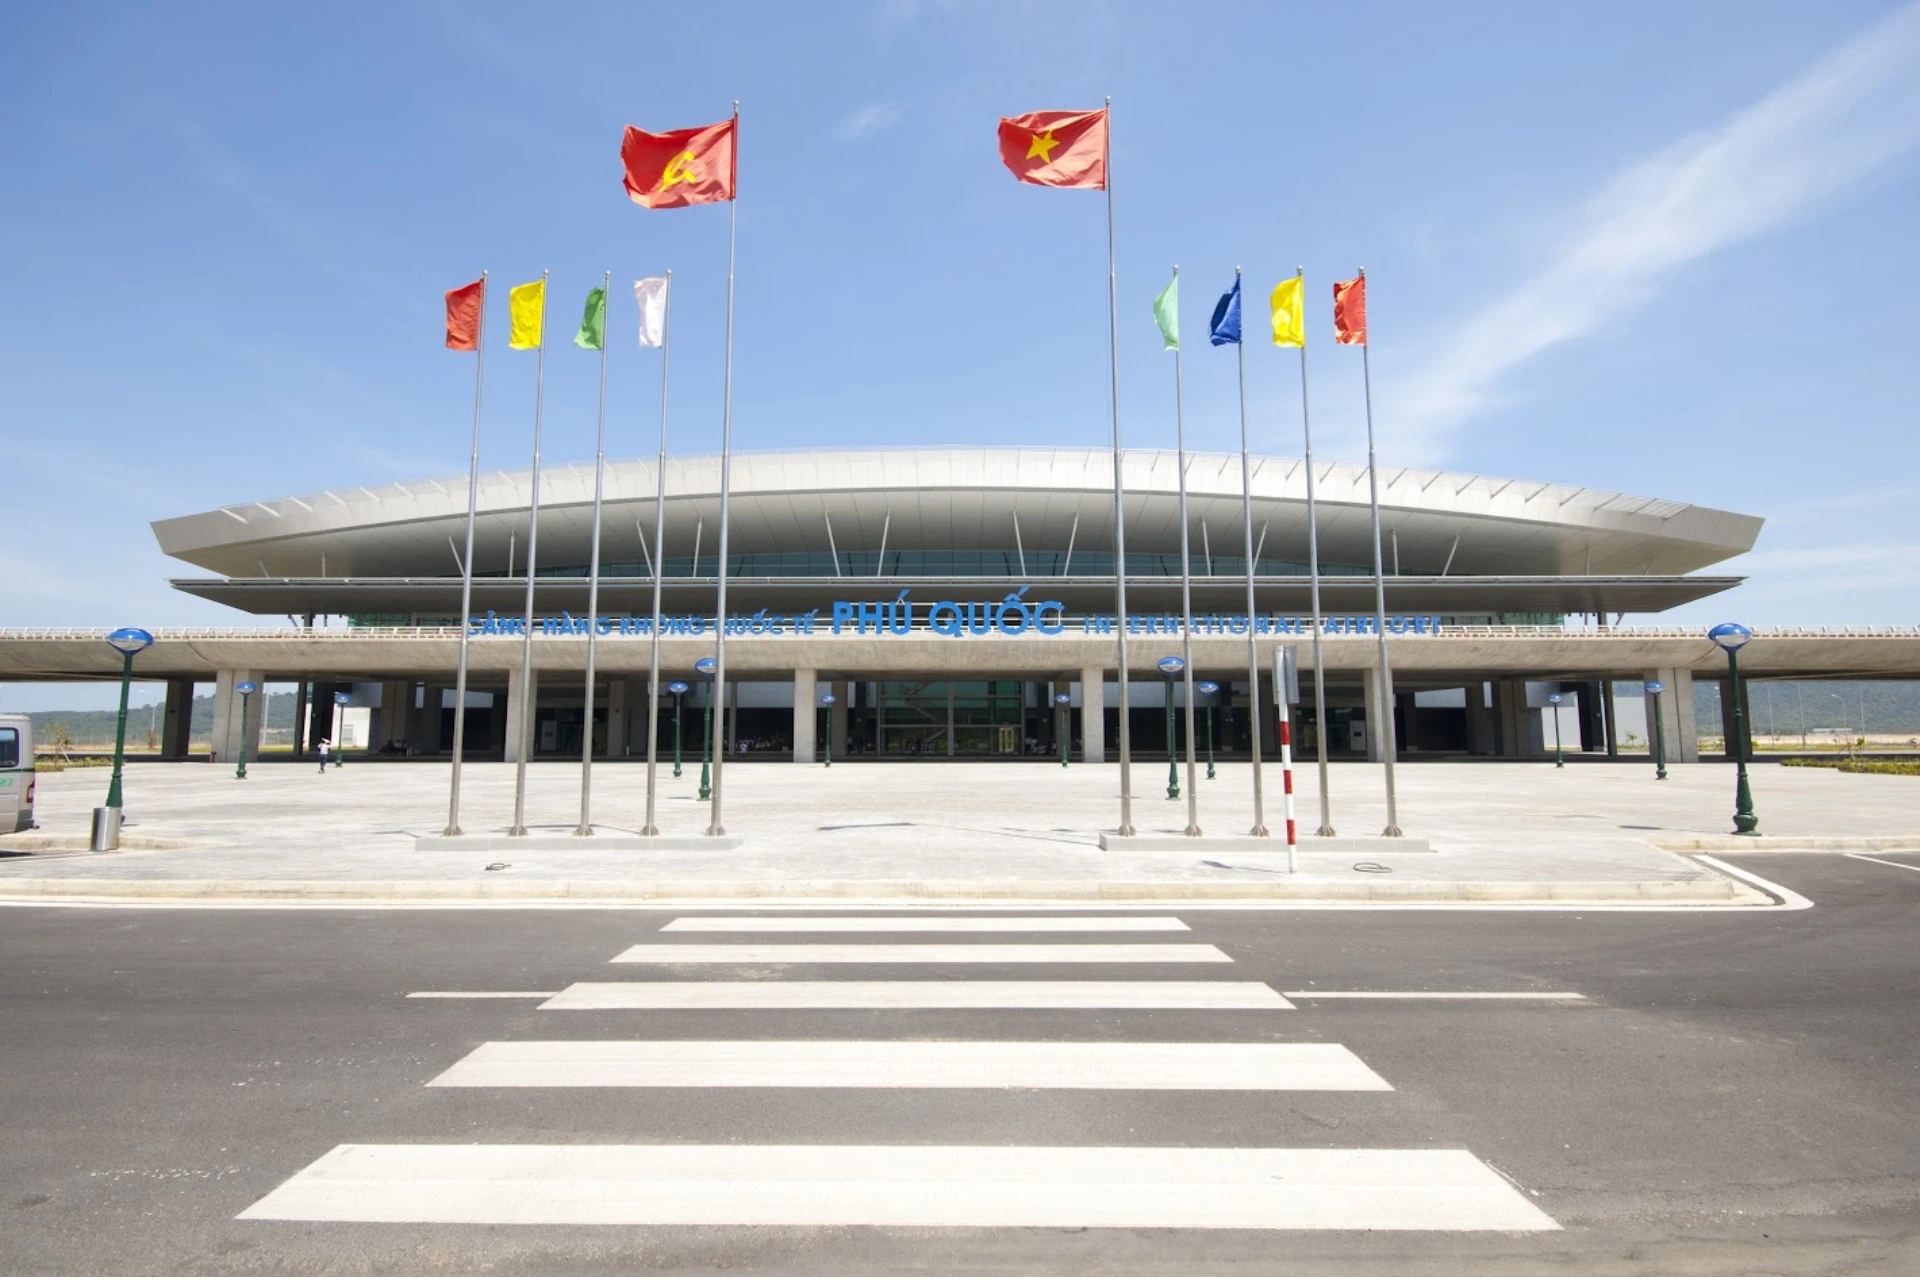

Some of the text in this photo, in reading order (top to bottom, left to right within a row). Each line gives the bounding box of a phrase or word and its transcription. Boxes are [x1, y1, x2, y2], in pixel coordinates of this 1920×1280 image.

[792, 607, 819, 635] TẾ
[833, 589, 912, 635] PHÚ
[928, 585, 1066, 637] QUỐC
[1083, 615, 1306, 634] INERNATIONAL
